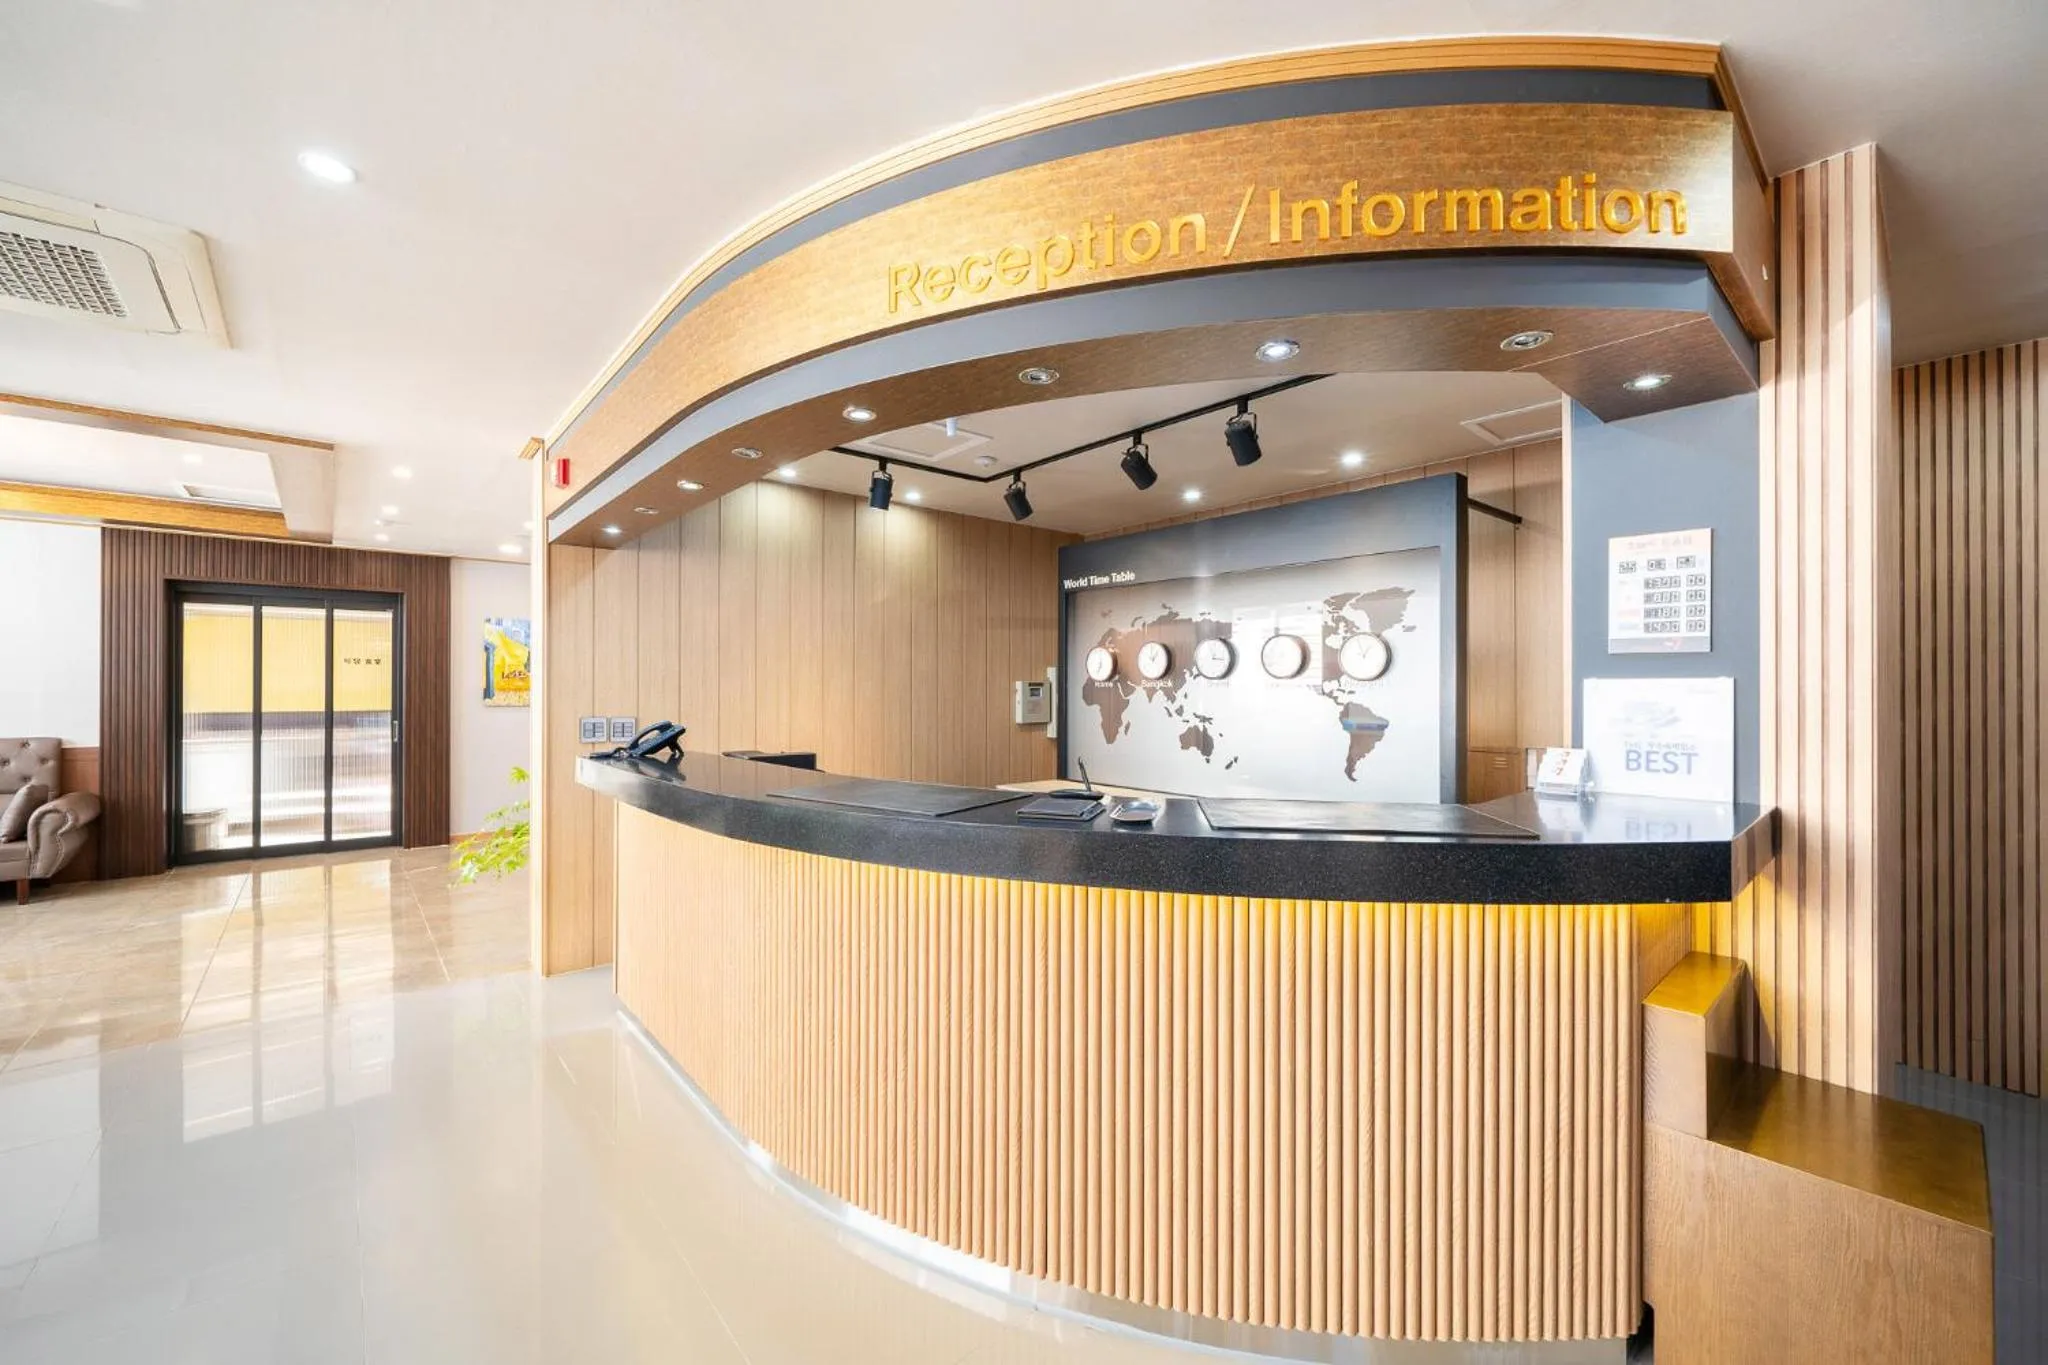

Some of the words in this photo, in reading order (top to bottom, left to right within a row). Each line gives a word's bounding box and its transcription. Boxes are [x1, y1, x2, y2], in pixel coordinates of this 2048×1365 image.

[887, 211, 1207, 314] Reception
[1269, 172, 1688, 244] Information
[1063, 577, 1088, 589] World
[1089, 575, 1110, 586] Time
[1111, 570, 1136, 582] Table
[1624, 749, 1700, 776] BEST
